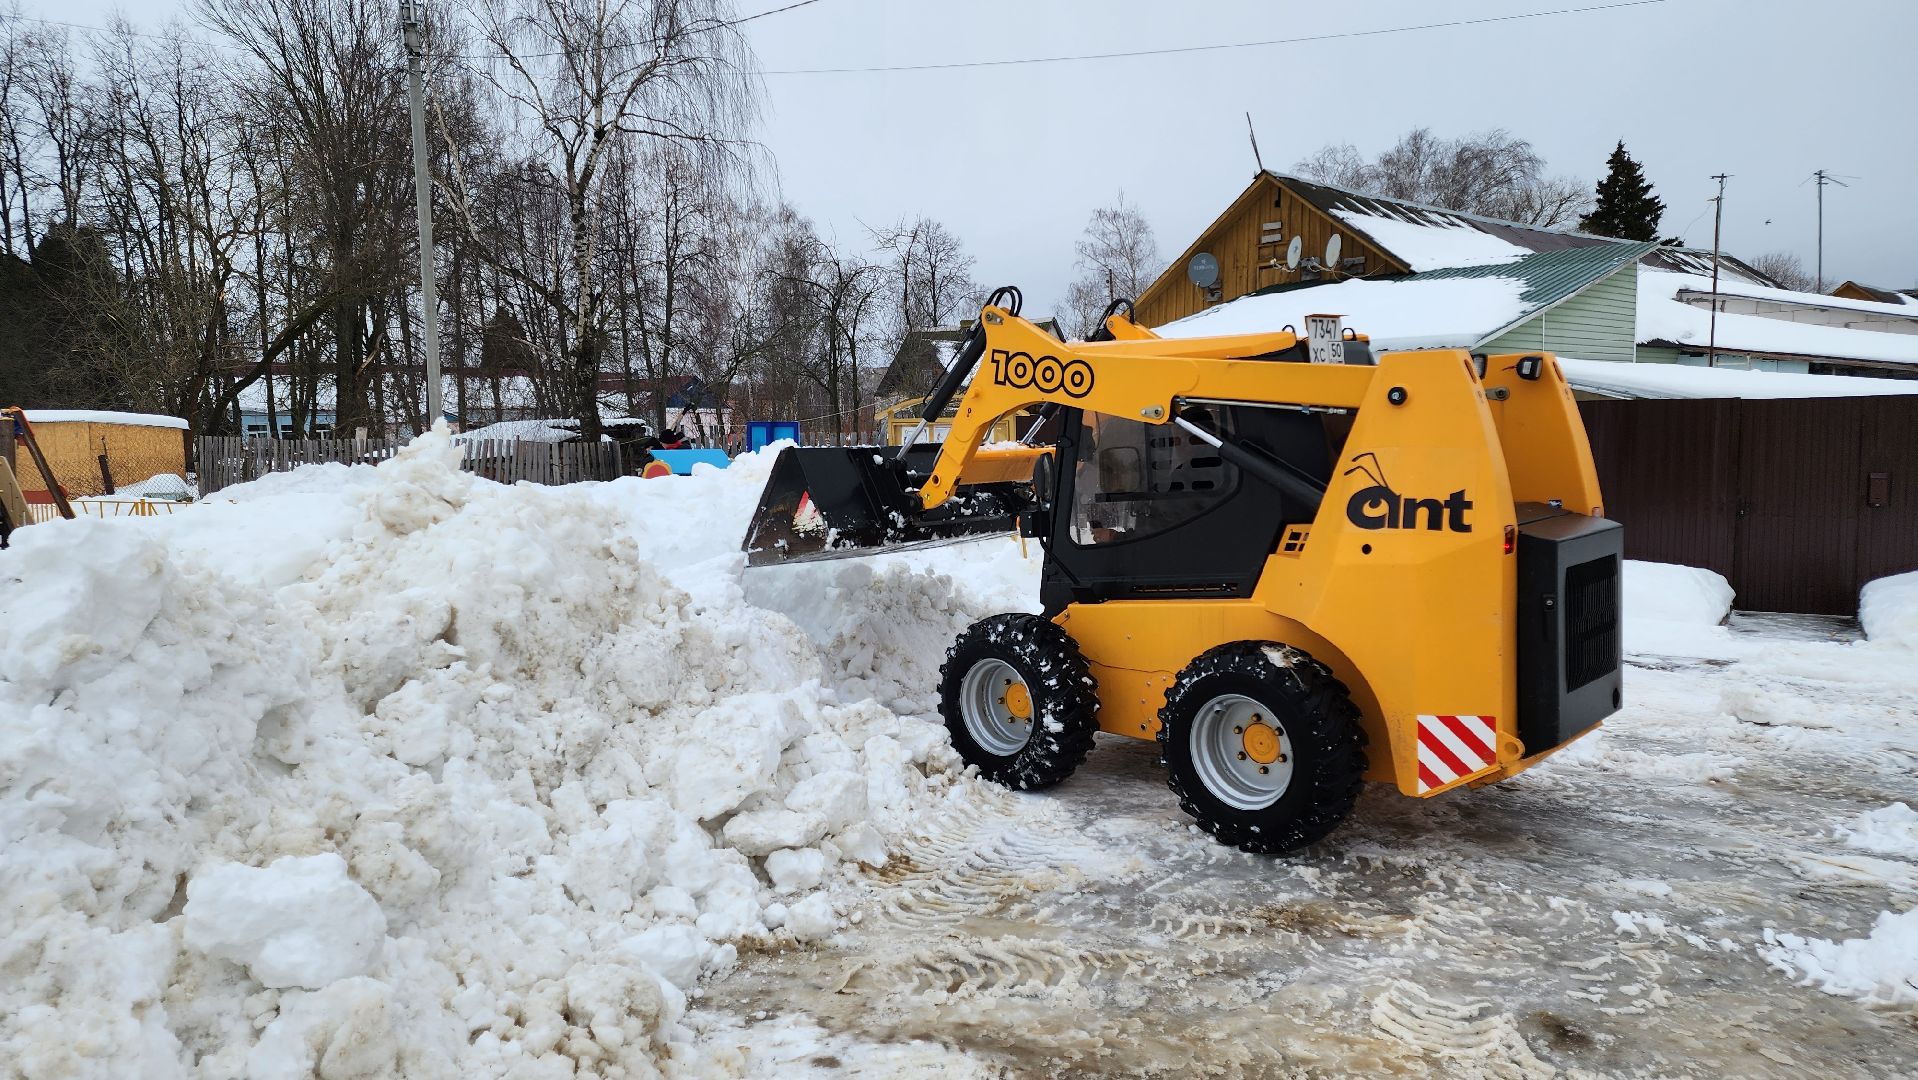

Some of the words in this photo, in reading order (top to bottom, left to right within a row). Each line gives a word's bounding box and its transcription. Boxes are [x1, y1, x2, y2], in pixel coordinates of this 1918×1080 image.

[1311, 319, 1336, 339] 7347
[1331, 343, 1342, 357] 50
[991, 349, 1095, 398] 1000
[1346, 485, 1473, 533] ant
